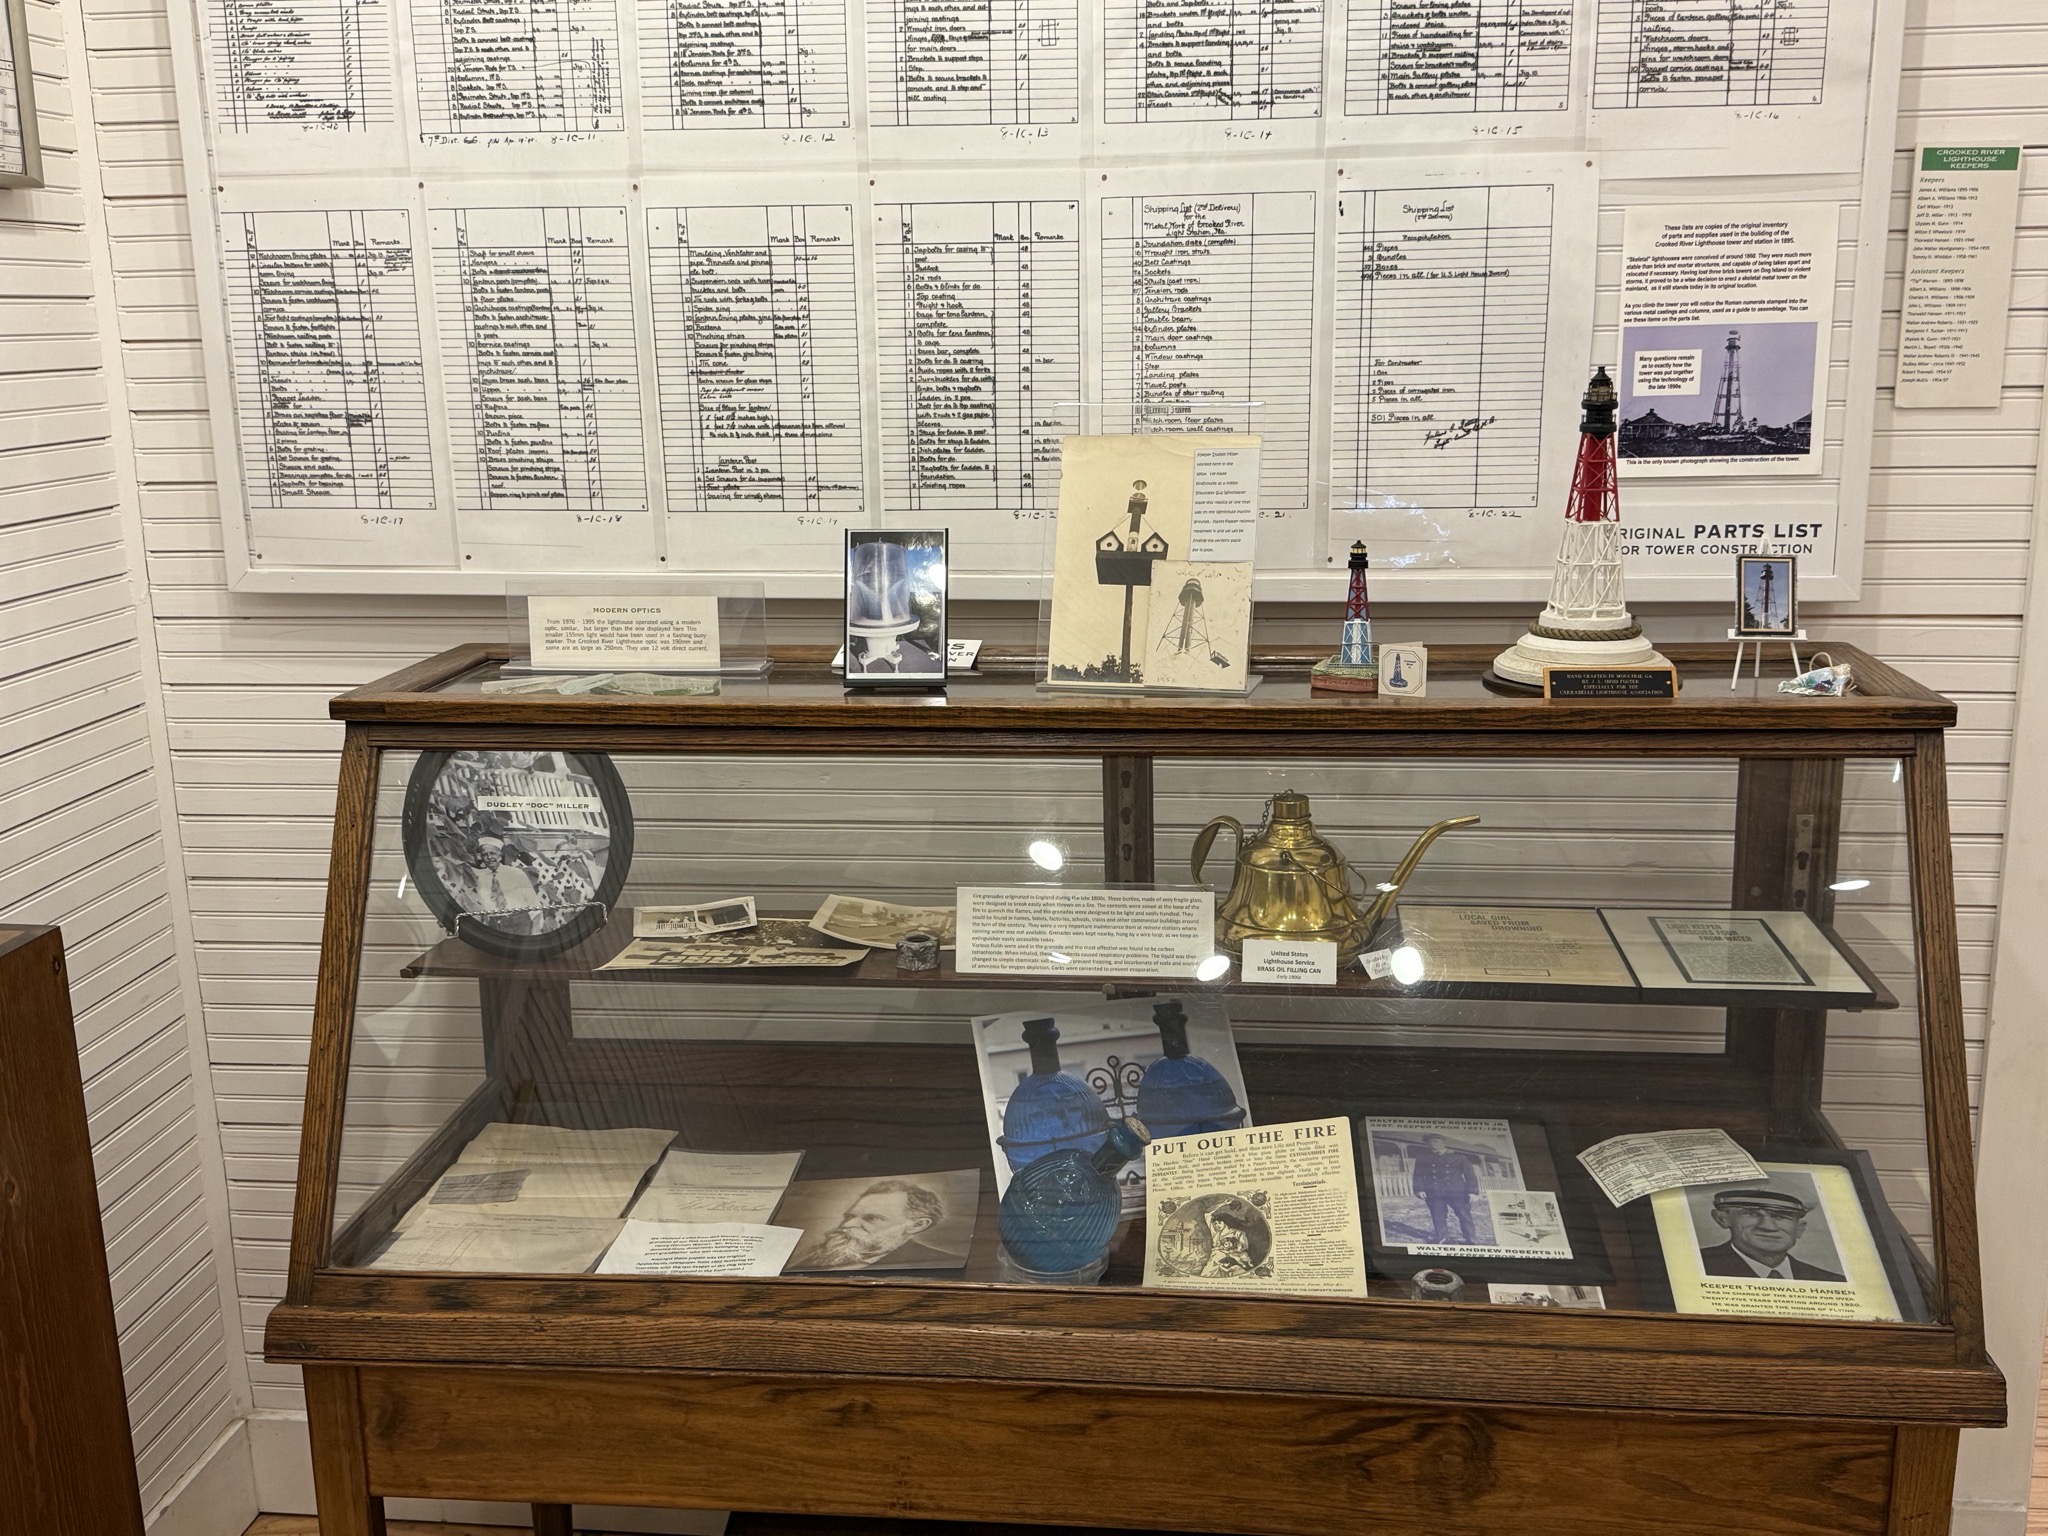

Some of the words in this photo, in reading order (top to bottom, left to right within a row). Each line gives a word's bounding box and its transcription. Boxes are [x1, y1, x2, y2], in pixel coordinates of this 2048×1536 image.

[1144, 204, 1178, 214] Shipping
[1180, 202, 1192, 214] List
[1402, 204, 1440, 214] Shipping
[1440, 200, 1454, 212] List
[1188, 221, 1195, 231] of
[1225, 219, 1245, 228] River
[1388, 413, 1409, 421] Pieces
[1620, 528, 1685, 539] RIGINAL
[1694, 524, 1764, 539] PARTS
[1774, 523, 1823, 538] LIST
[1646, 545, 1695, 555] TOWER
[1700, 544, 1813, 554] CONSTRCTION
[1152, 1142, 1187, 1156] PUT
[1197, 1136, 1236, 1150] OUT
[1246, 1130, 1283, 1145] THE
[1294, 1125, 1337, 1140] FIRE
[1746, 1284, 1806, 1293] THORWALD
[1810, 1287, 1856, 1295] HANSEN
